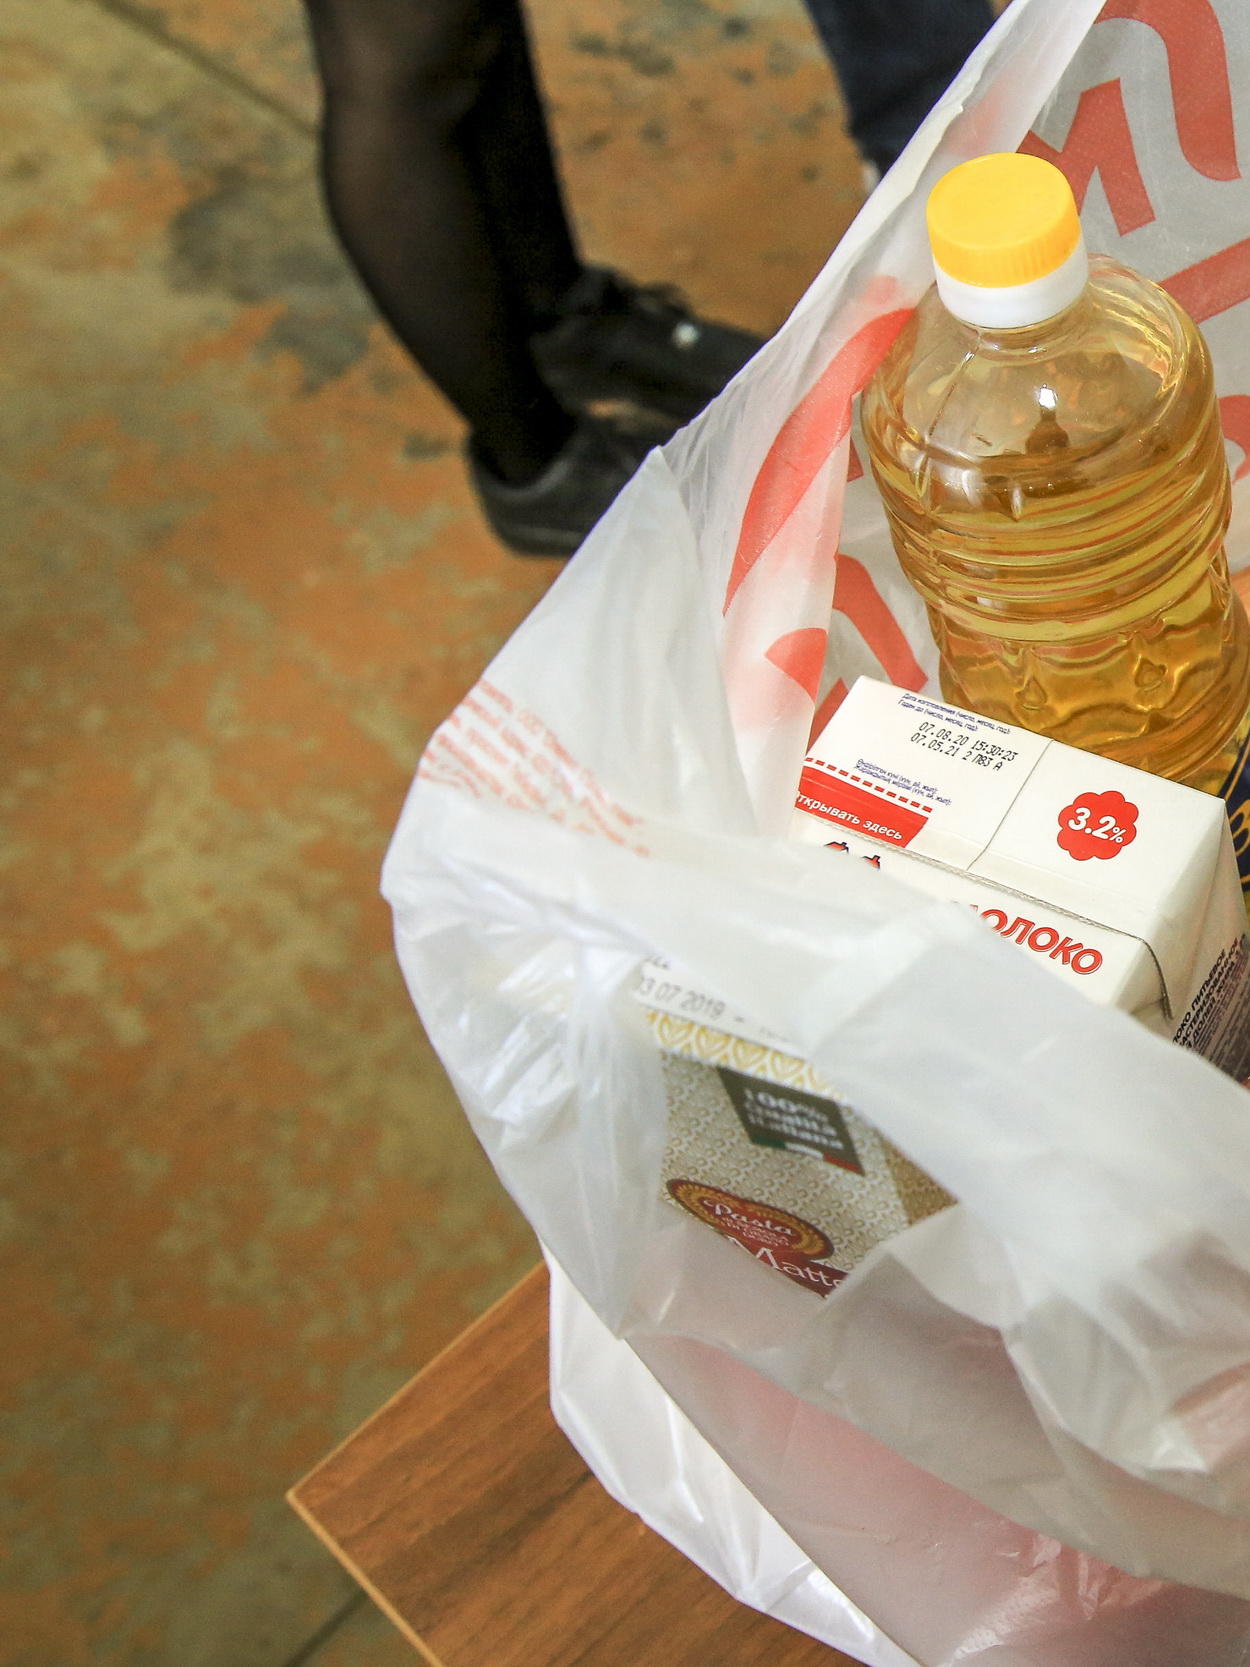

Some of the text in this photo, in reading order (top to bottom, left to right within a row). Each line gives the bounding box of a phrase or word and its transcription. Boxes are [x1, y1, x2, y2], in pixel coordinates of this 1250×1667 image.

[910, 732, 960, 758] 07.05.21
[919, 722, 970, 746] 07.08.20
[862, 819, 903, 840] здесь
[1068, 807, 1127, 844] 3.2%
[970, 904, 1103, 976] ОЛОКО
[1179, 937, 1239, 1046] АСТЕРИЗОВАННОЕ
[1173, 1011, 1191, 1043] ЛОКО
[703, 1200, 797, 1236] Pasta
